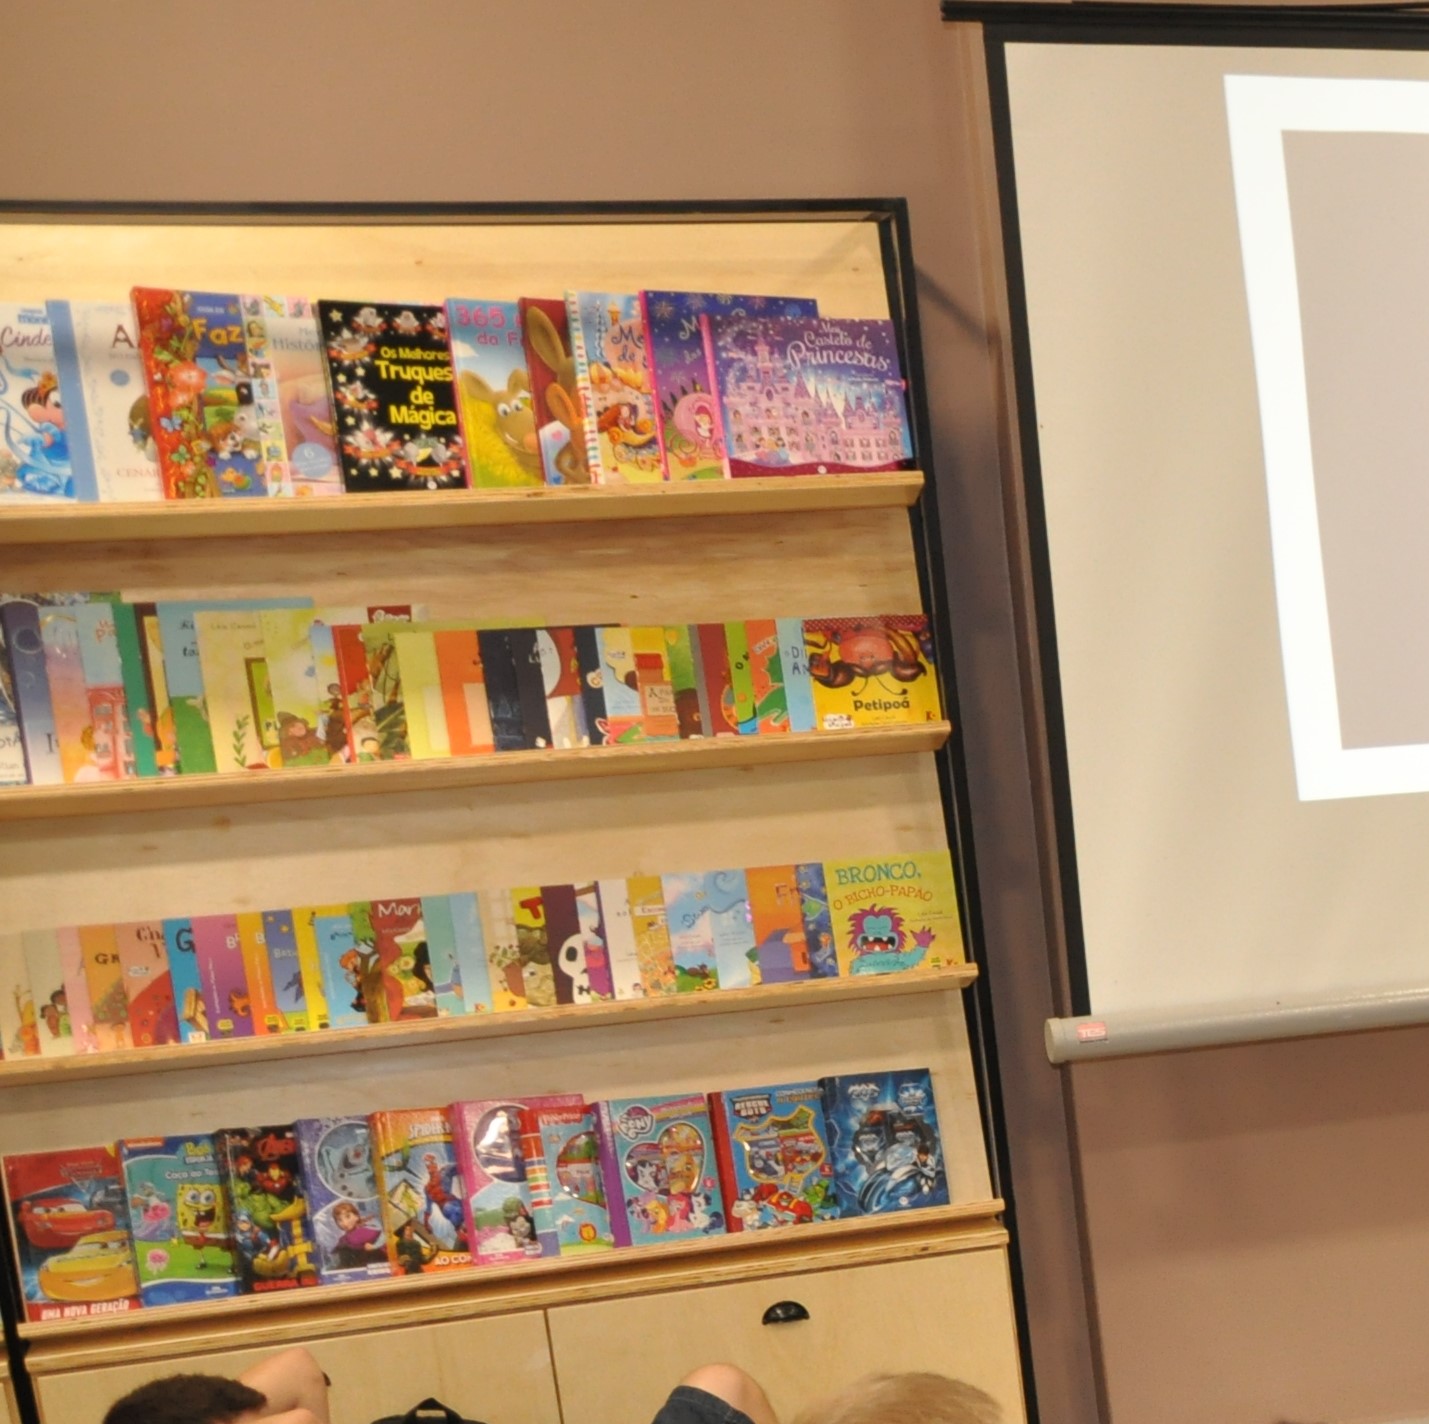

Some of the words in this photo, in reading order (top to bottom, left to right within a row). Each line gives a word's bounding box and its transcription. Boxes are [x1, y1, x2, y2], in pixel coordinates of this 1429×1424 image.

[455, 304, 506, 329] 365
[804, 331, 852, 348] Castelo
[856, 334, 873, 349] de
[380, 346, 397, 359] Os
[398, 347, 450, 361] Melhores
[786, 340, 889, 371] Princesas
[374, 360, 453, 385] Truques
[410, 386, 435, 405] de
[389, 405, 457, 430] Mágica
[853, 696, 911, 714] Petipoá
[835, 861, 922, 886] BRONCO,
[1079, 1027, 1107, 1038] TES
[41, 1308, 61, 1321] UMA
[63, 1305, 88, 1318] NOVA
[90, 1298, 130, 1316] GERAÇÃO
